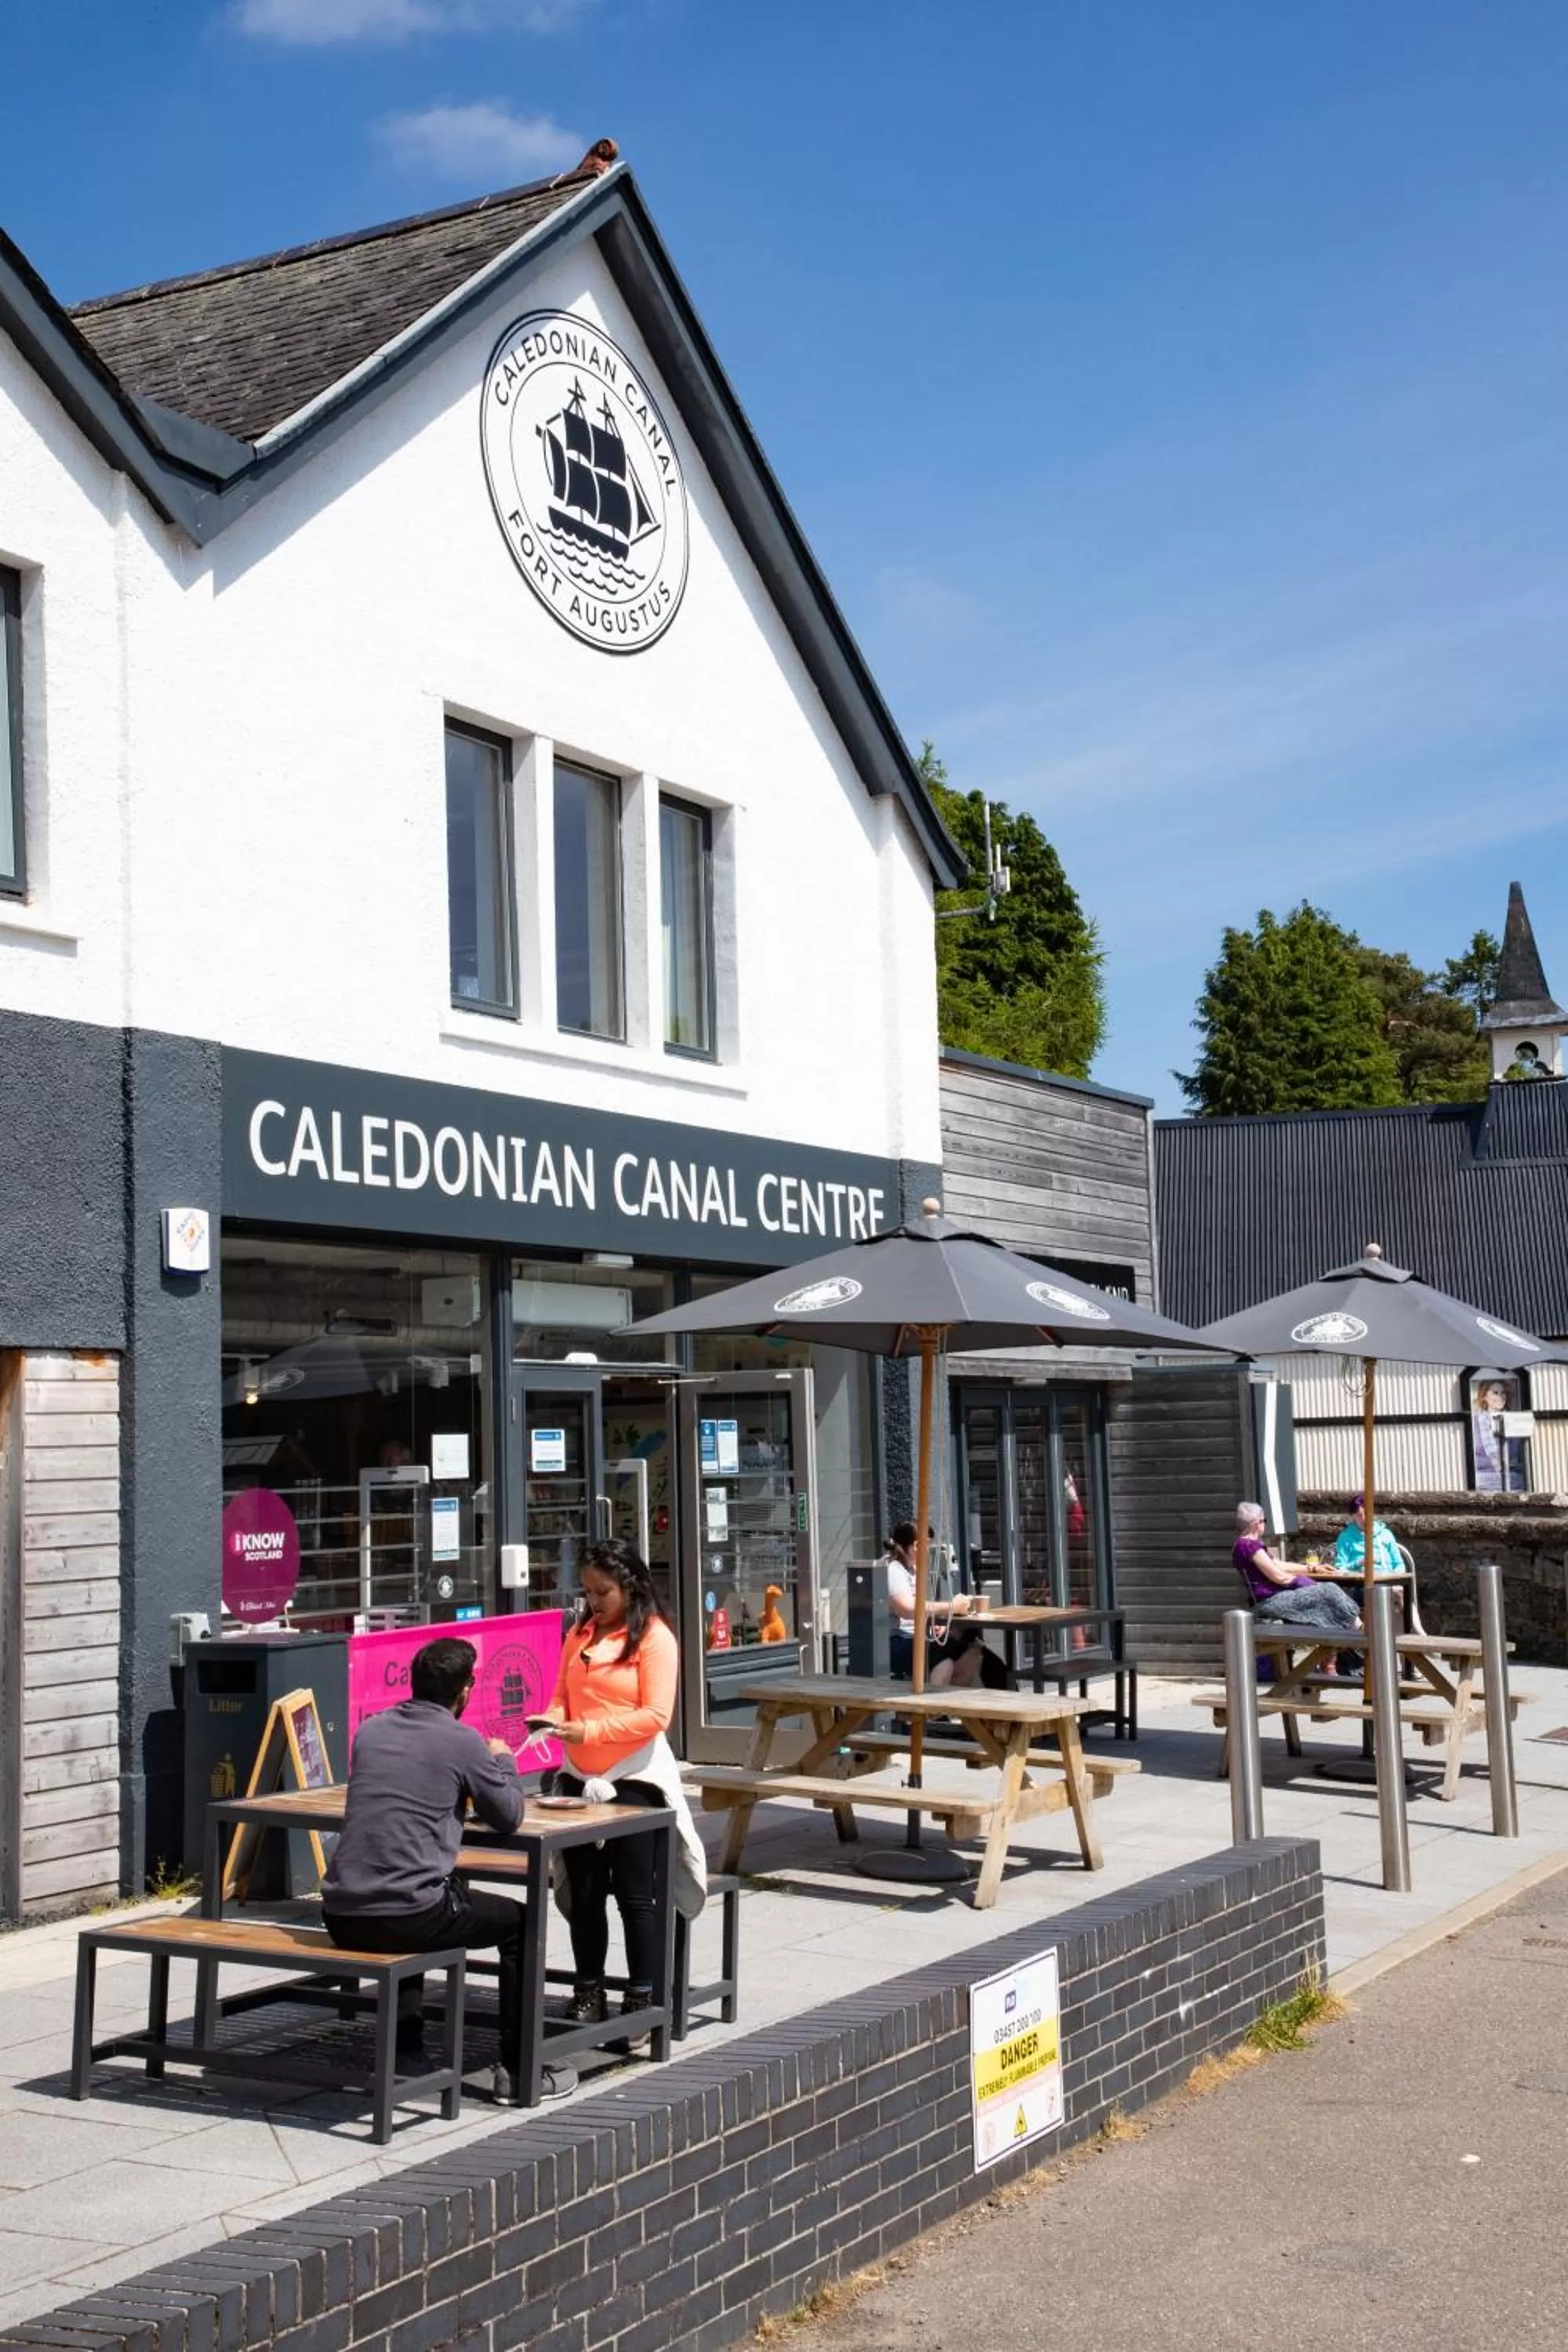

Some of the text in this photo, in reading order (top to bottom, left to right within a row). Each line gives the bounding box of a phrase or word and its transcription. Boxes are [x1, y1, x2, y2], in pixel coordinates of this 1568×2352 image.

[495, 330, 675, 497] CALEDONIAN CANAL
[509, 510, 671, 634] FORT AUGUSTUS
[248, 1099, 884, 1240] CALEDONIAN CANAL CENTRE
[244, 1550, 284, 1562] SCOTLAND
[1000, 2031, 1039, 2070] DANGER
